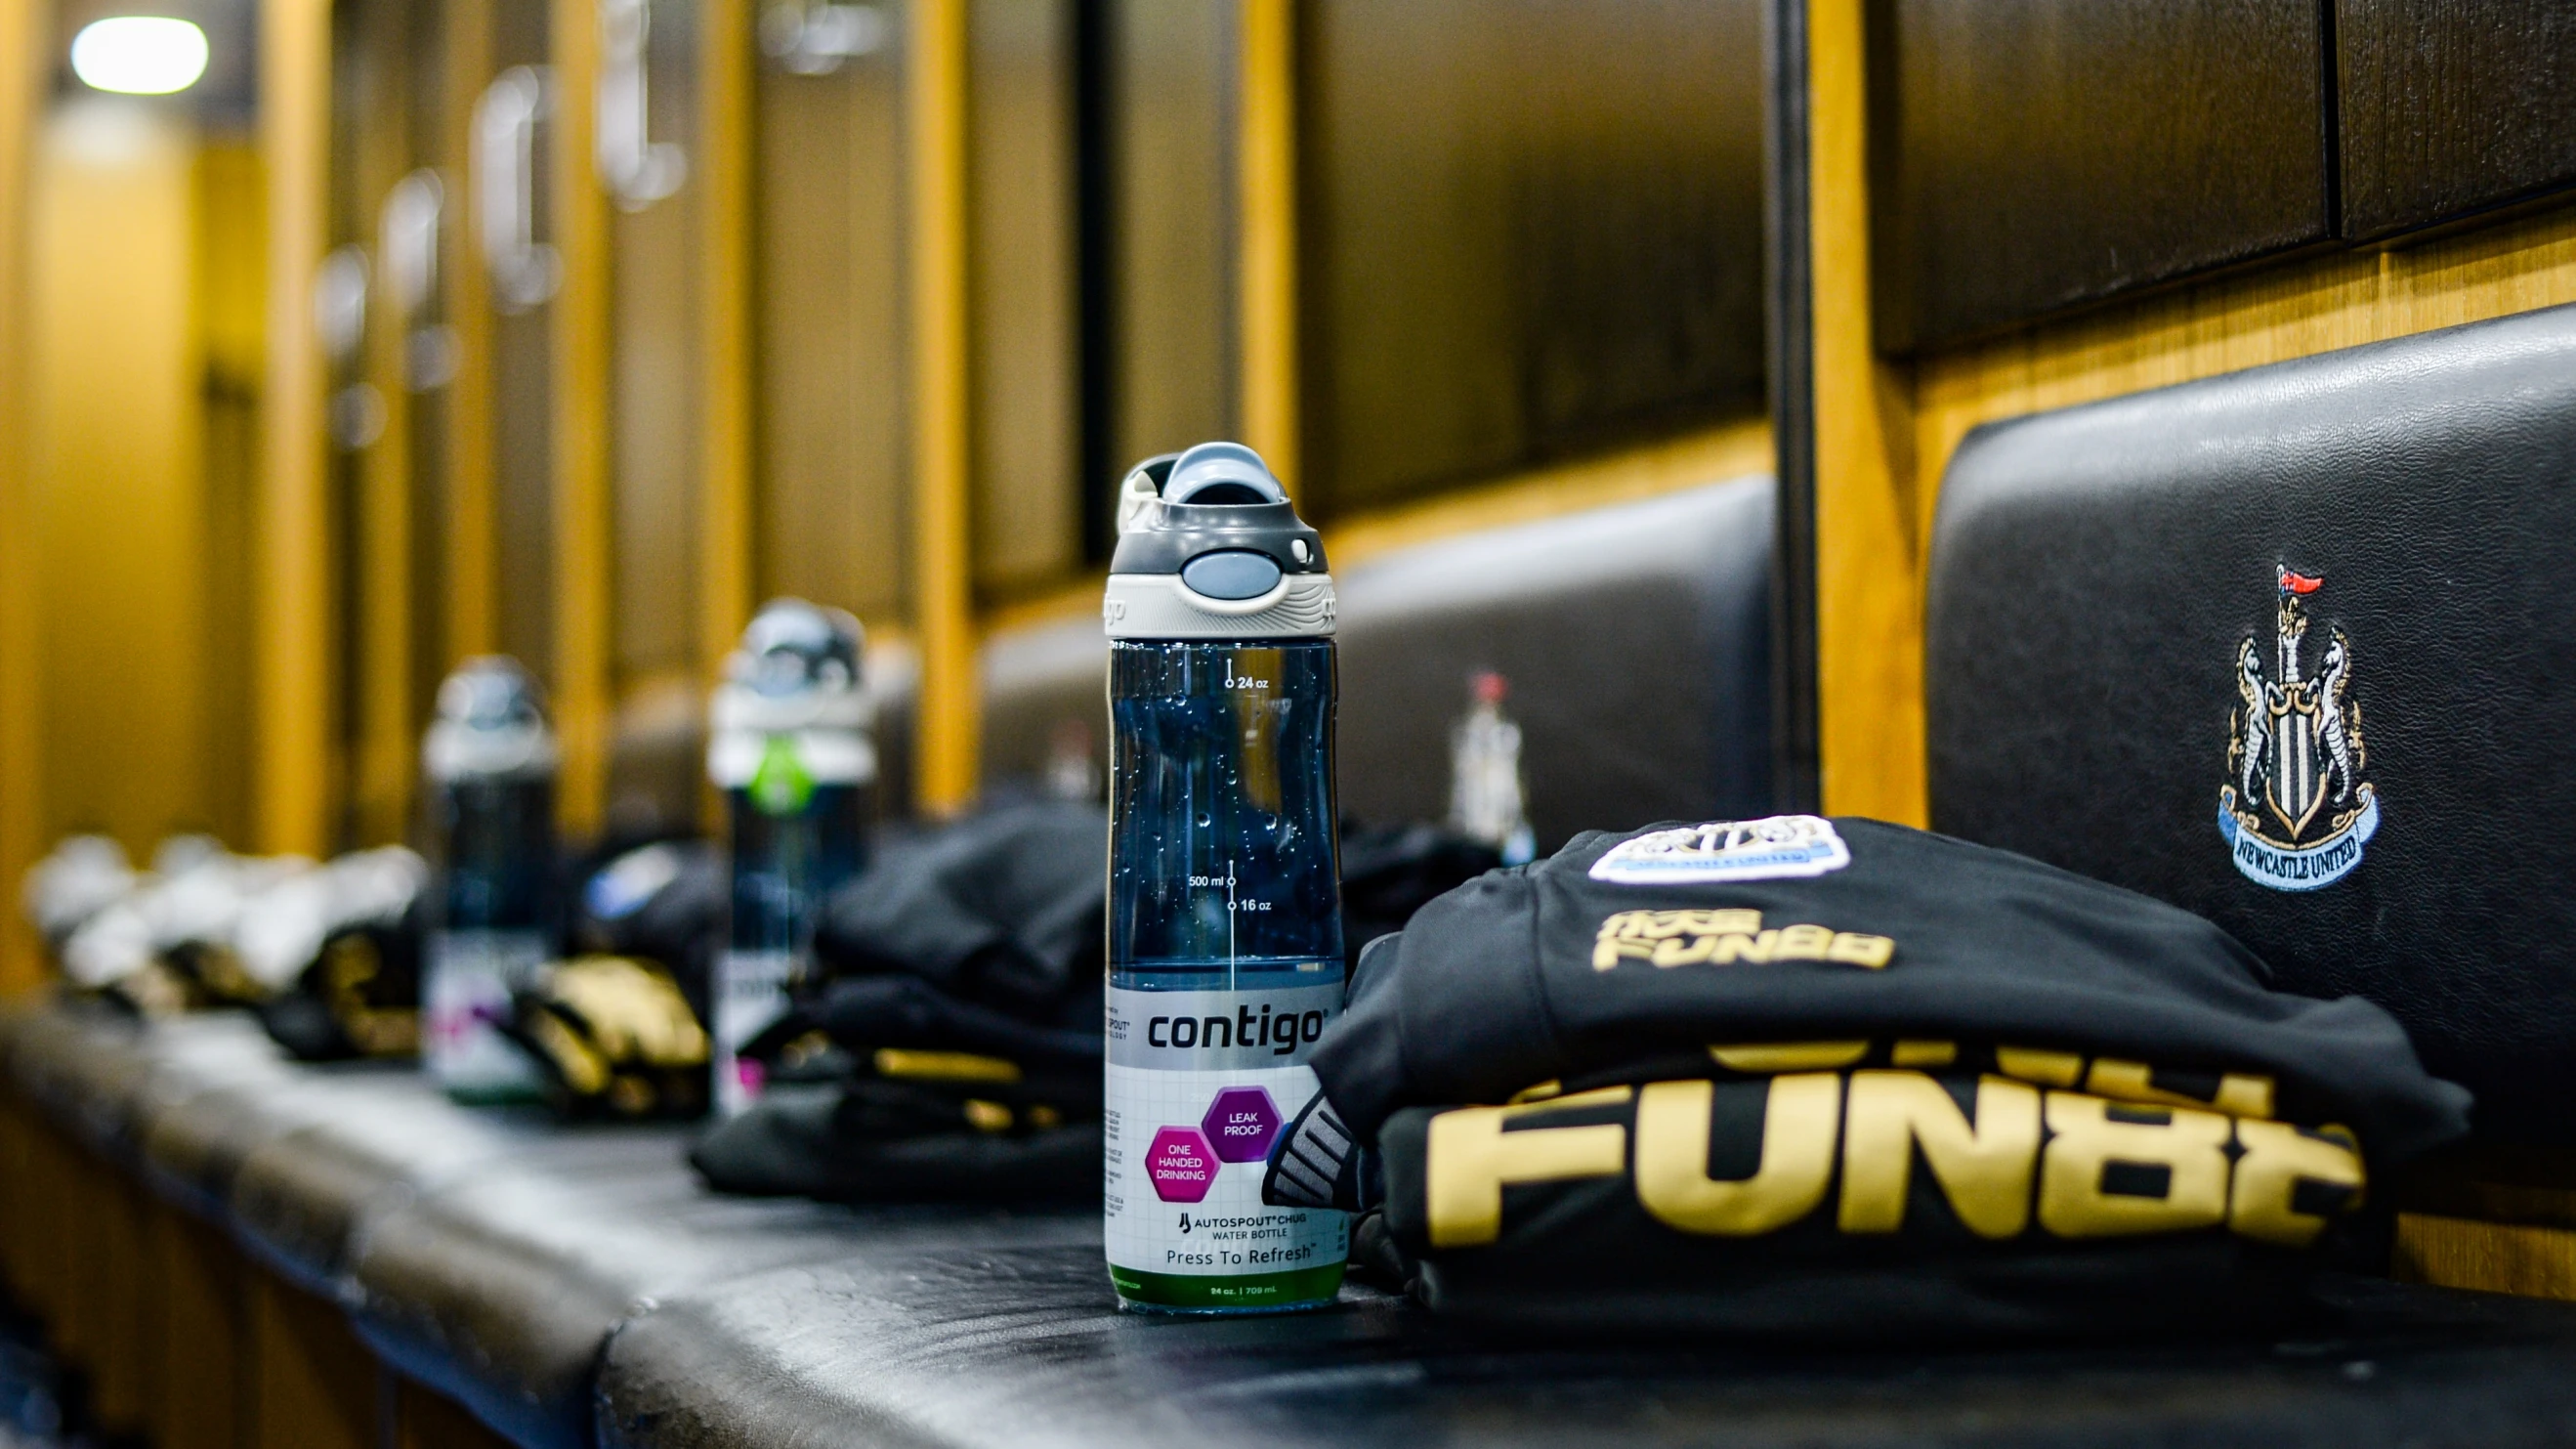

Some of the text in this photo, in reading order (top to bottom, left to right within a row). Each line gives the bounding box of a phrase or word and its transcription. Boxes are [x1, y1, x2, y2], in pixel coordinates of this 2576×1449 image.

[1238, 677, 1269, 689] 24 oz
[2236, 834, 2357, 880] NEWCASTLE UNITED
[1189, 875, 1224, 886] 500 ml
[1241, 900, 1272, 911] 16 oz
[1591, 923, 1896, 972] FUN88
[1229, 1112, 1258, 1124] LEAK
[1224, 1125, 1263, 1136] PROOF
[1167, 1144, 1192, 1156] ONE
[1158, 1157, 1204, 1170] HANDED
[1156, 1170, 1206, 1181] DRINKING
[1278, 1213, 1307, 1224] CHUG
[1212, 1227, 1288, 1240] WATER BOTTLE
[1166, 1250, 1213, 1265] Press
[1219, 1251, 1242, 1265] To
